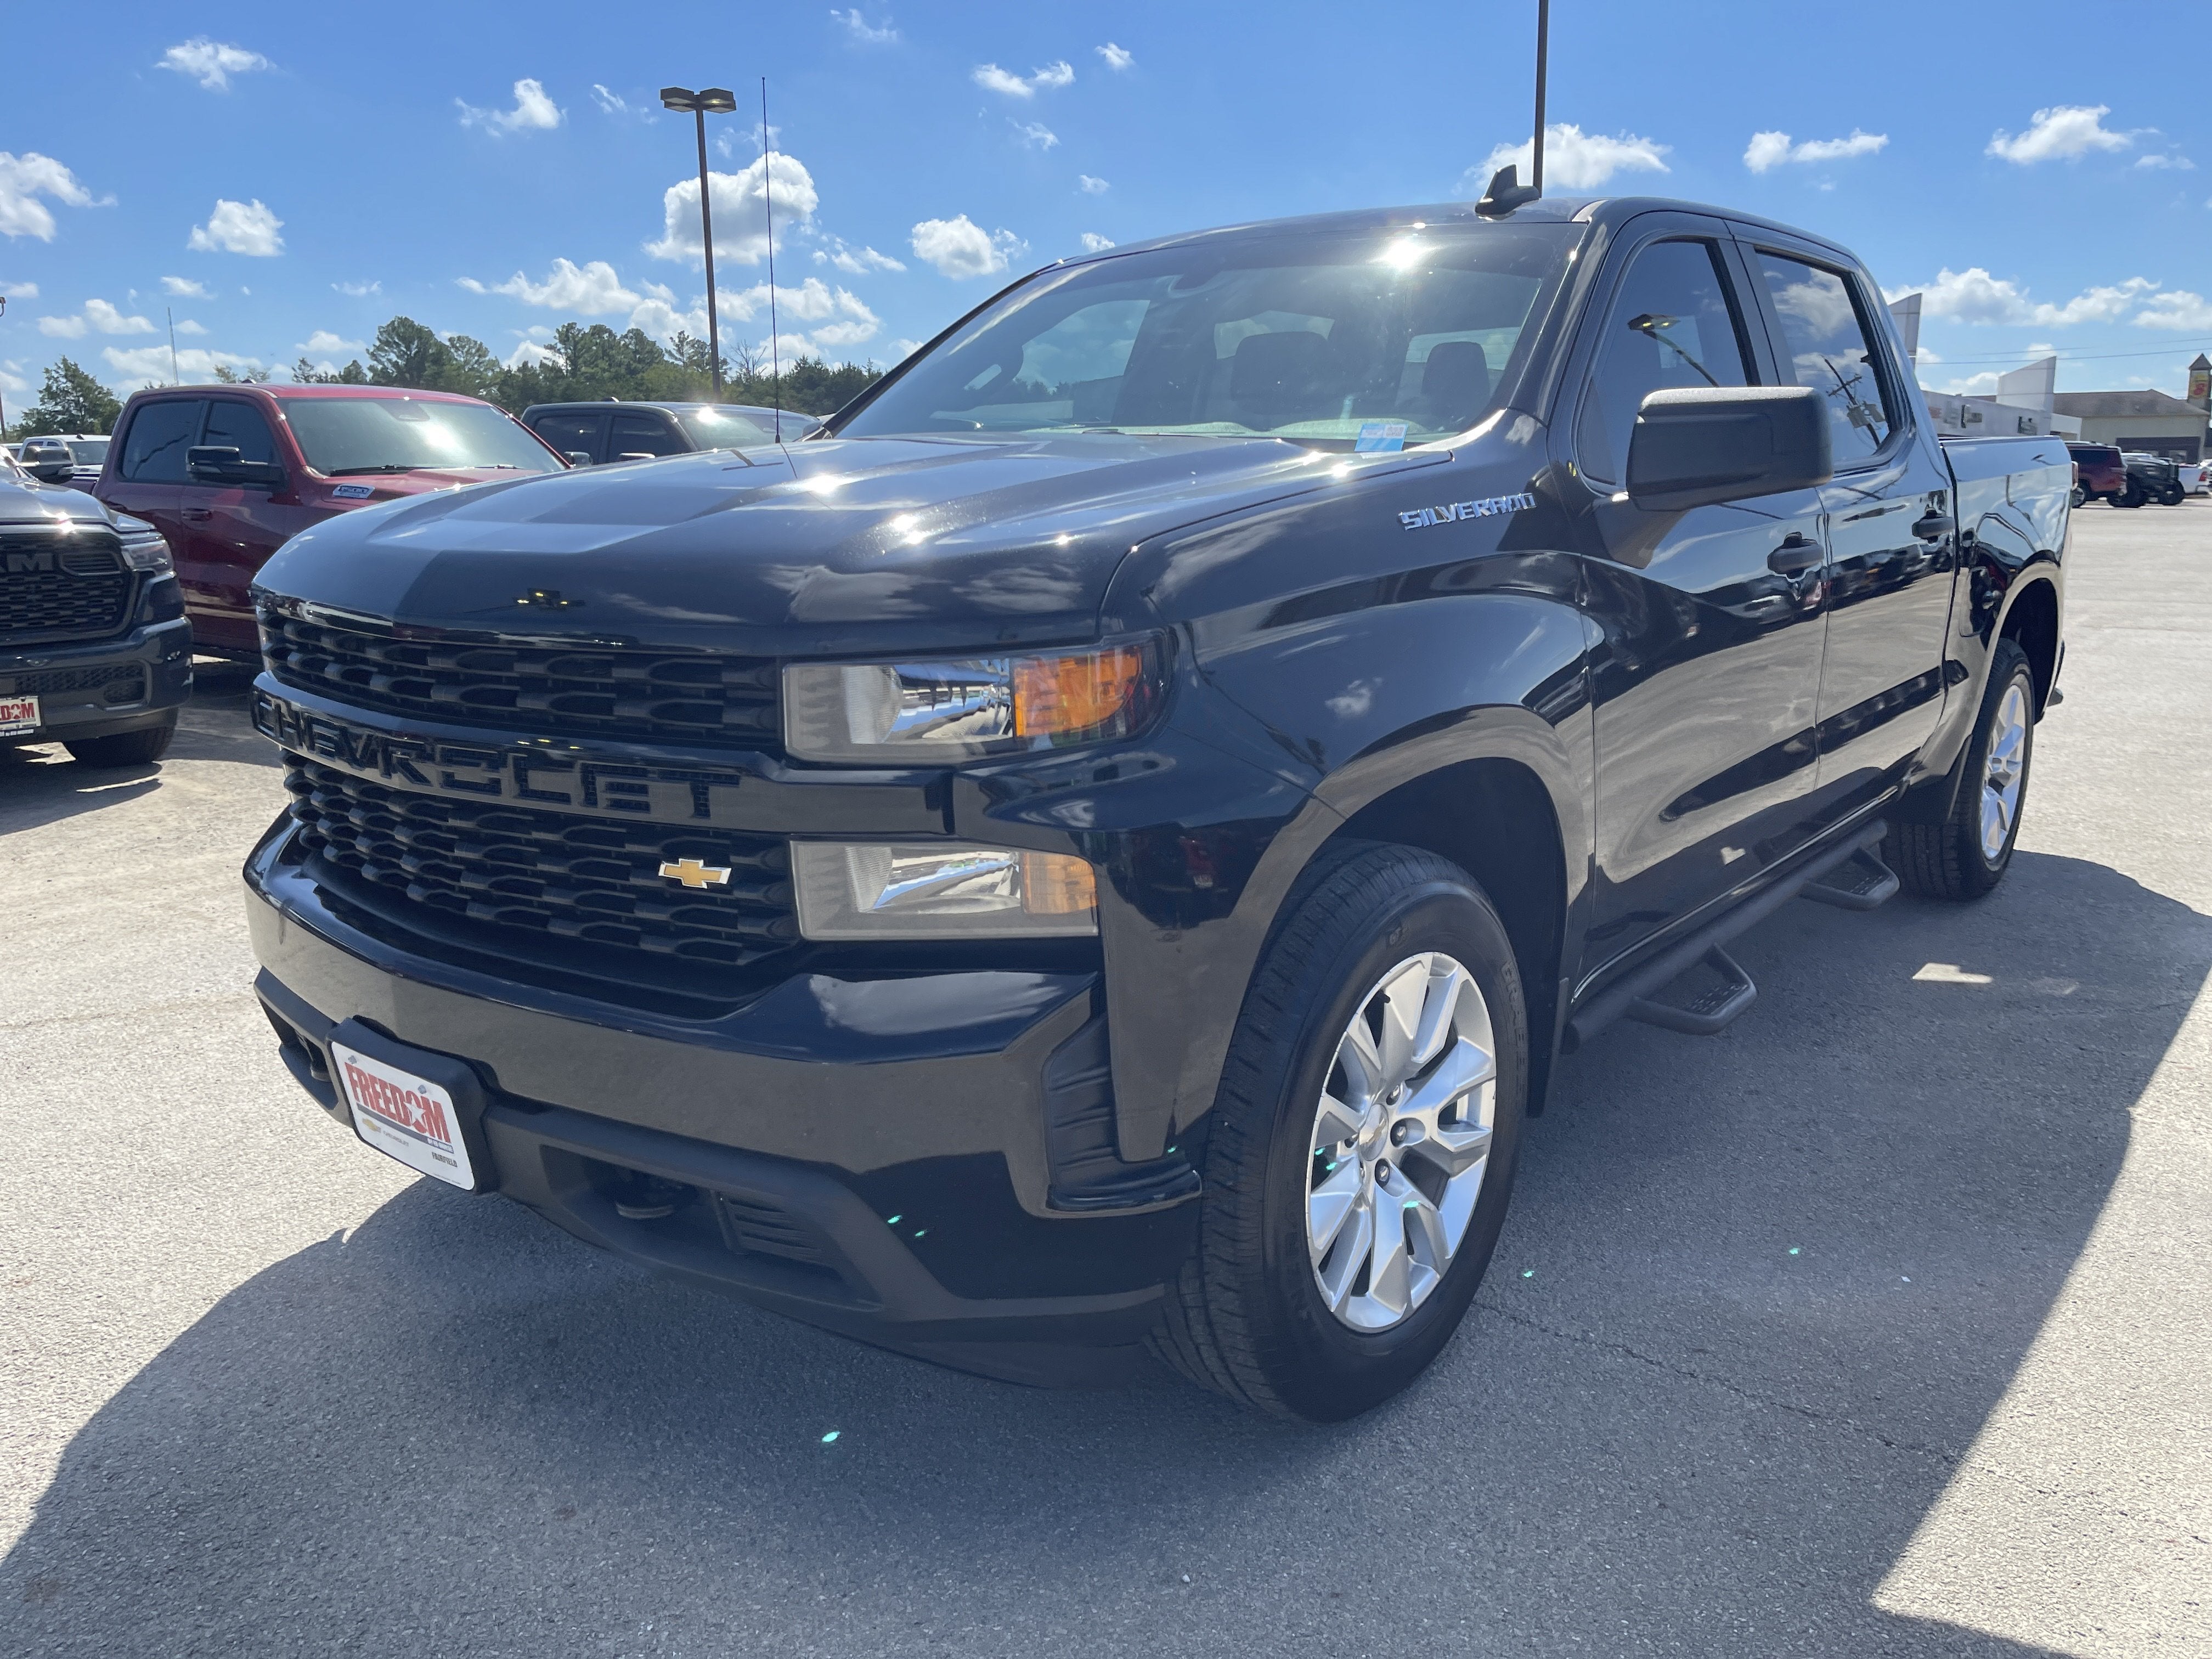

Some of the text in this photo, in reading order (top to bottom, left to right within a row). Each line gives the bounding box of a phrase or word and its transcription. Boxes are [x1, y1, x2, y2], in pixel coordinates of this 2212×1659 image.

[1399, 493, 1537, 530] SILVERADO
[250, 687, 741, 820] CHEVROLET
[345, 1062, 451, 1143] FREEDOM
